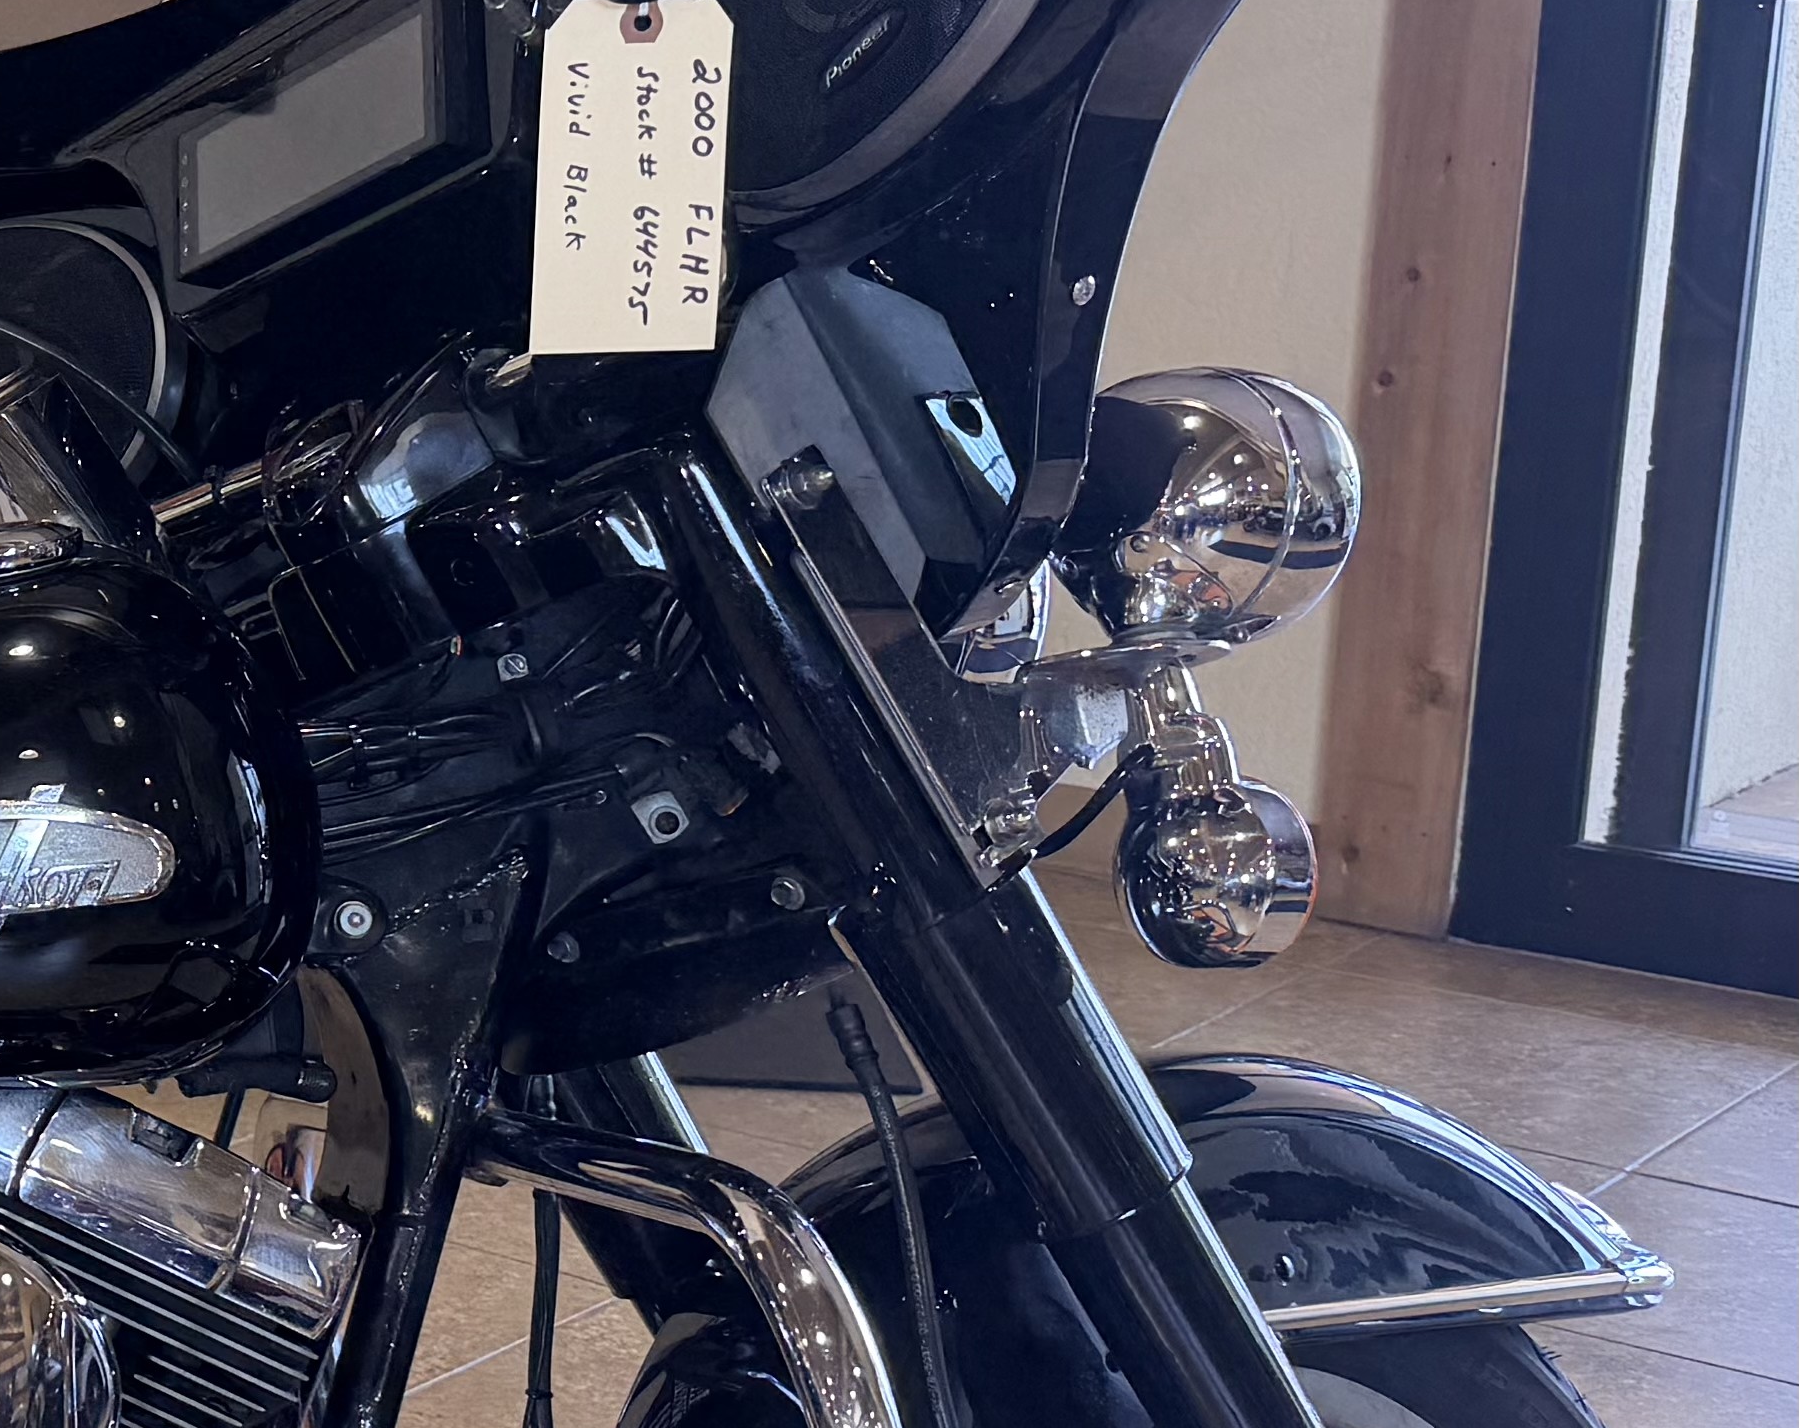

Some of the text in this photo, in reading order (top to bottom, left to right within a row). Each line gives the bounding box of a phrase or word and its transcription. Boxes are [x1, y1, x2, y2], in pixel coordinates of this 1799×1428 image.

[565, 165, 588, 249] Black
[629, 67, 659, 325] Stock # 644575
[680, 59, 721, 303] 2000 FLHR
